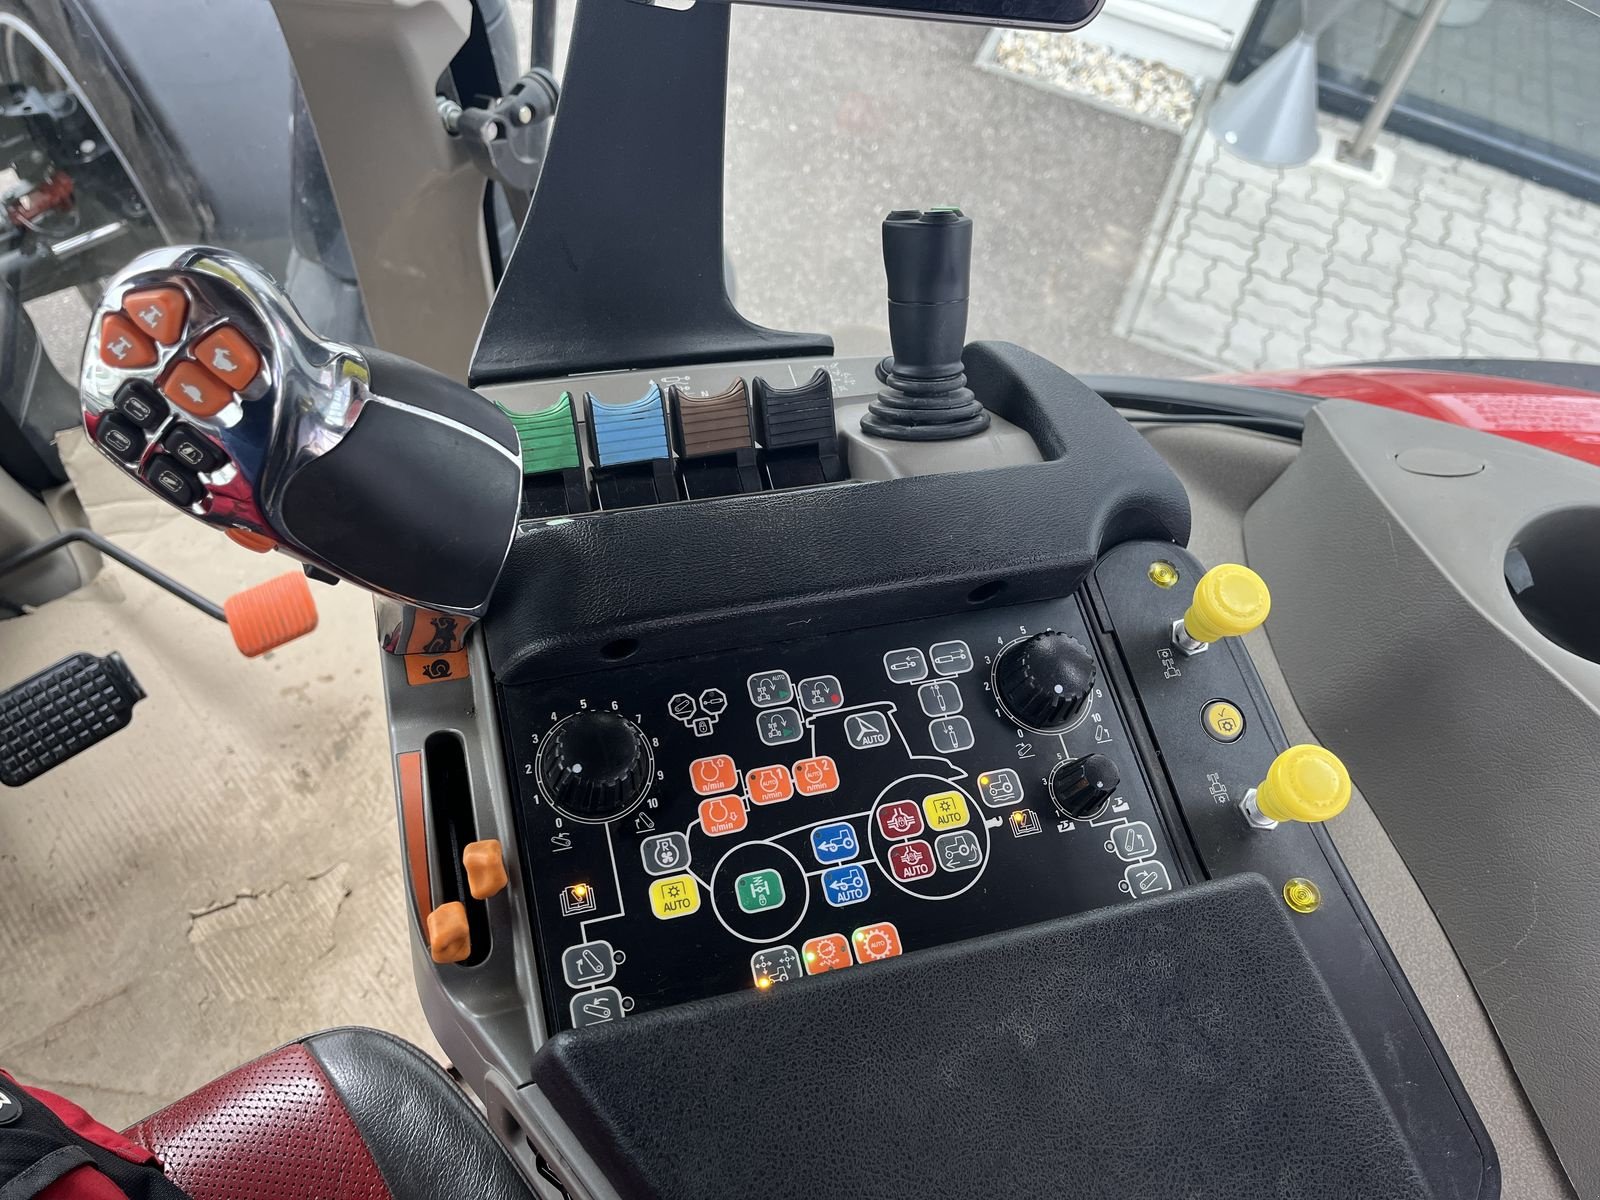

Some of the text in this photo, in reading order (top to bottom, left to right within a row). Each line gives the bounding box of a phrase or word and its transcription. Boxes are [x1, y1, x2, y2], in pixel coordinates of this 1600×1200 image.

[1020, 625, 1026, 634] 5
[997, 636, 1004, 645] 4
[984, 655, 991, 664] 3
[984, 682, 991, 691] 2
[1096, 689, 1102, 698] 9
[580, 699, 587, 709] 5
[611, 700, 618, 710] 6
[551, 712, 558, 721] 4
[995, 708, 1001, 718] 1
[1091, 712, 1102, 722] 10
[635, 714, 642, 724] 7
[1017, 729, 1024, 738] 0
[532, 734, 539, 744] 3
[652, 738, 660, 747] 8
[862, 734, 885, 745] AUTO
[525, 764, 532, 774] 2
[822, 760, 830, 770] 2
[657, 770, 664, 780] 9
[776, 768, 782, 779] 1
[702, 780, 725, 791] n/min
[806, 782, 827, 792] n/min
[1042, 778, 1048, 786] 3
[533, 794, 540, 804] 1
[762, 791, 782, 800] n/min
[647, 798, 658, 808] 10
[555, 818, 562, 828] 0
[937, 812, 962, 825] AUTO
[710, 822, 734, 833] n/min
[662, 841, 669, 851] R
[904, 864, 928, 878] AUTO
[838, 888, 863, 903] AUTO
[664, 898, 690, 912] AUTO
[871, 940, 884, 948] AUTO
